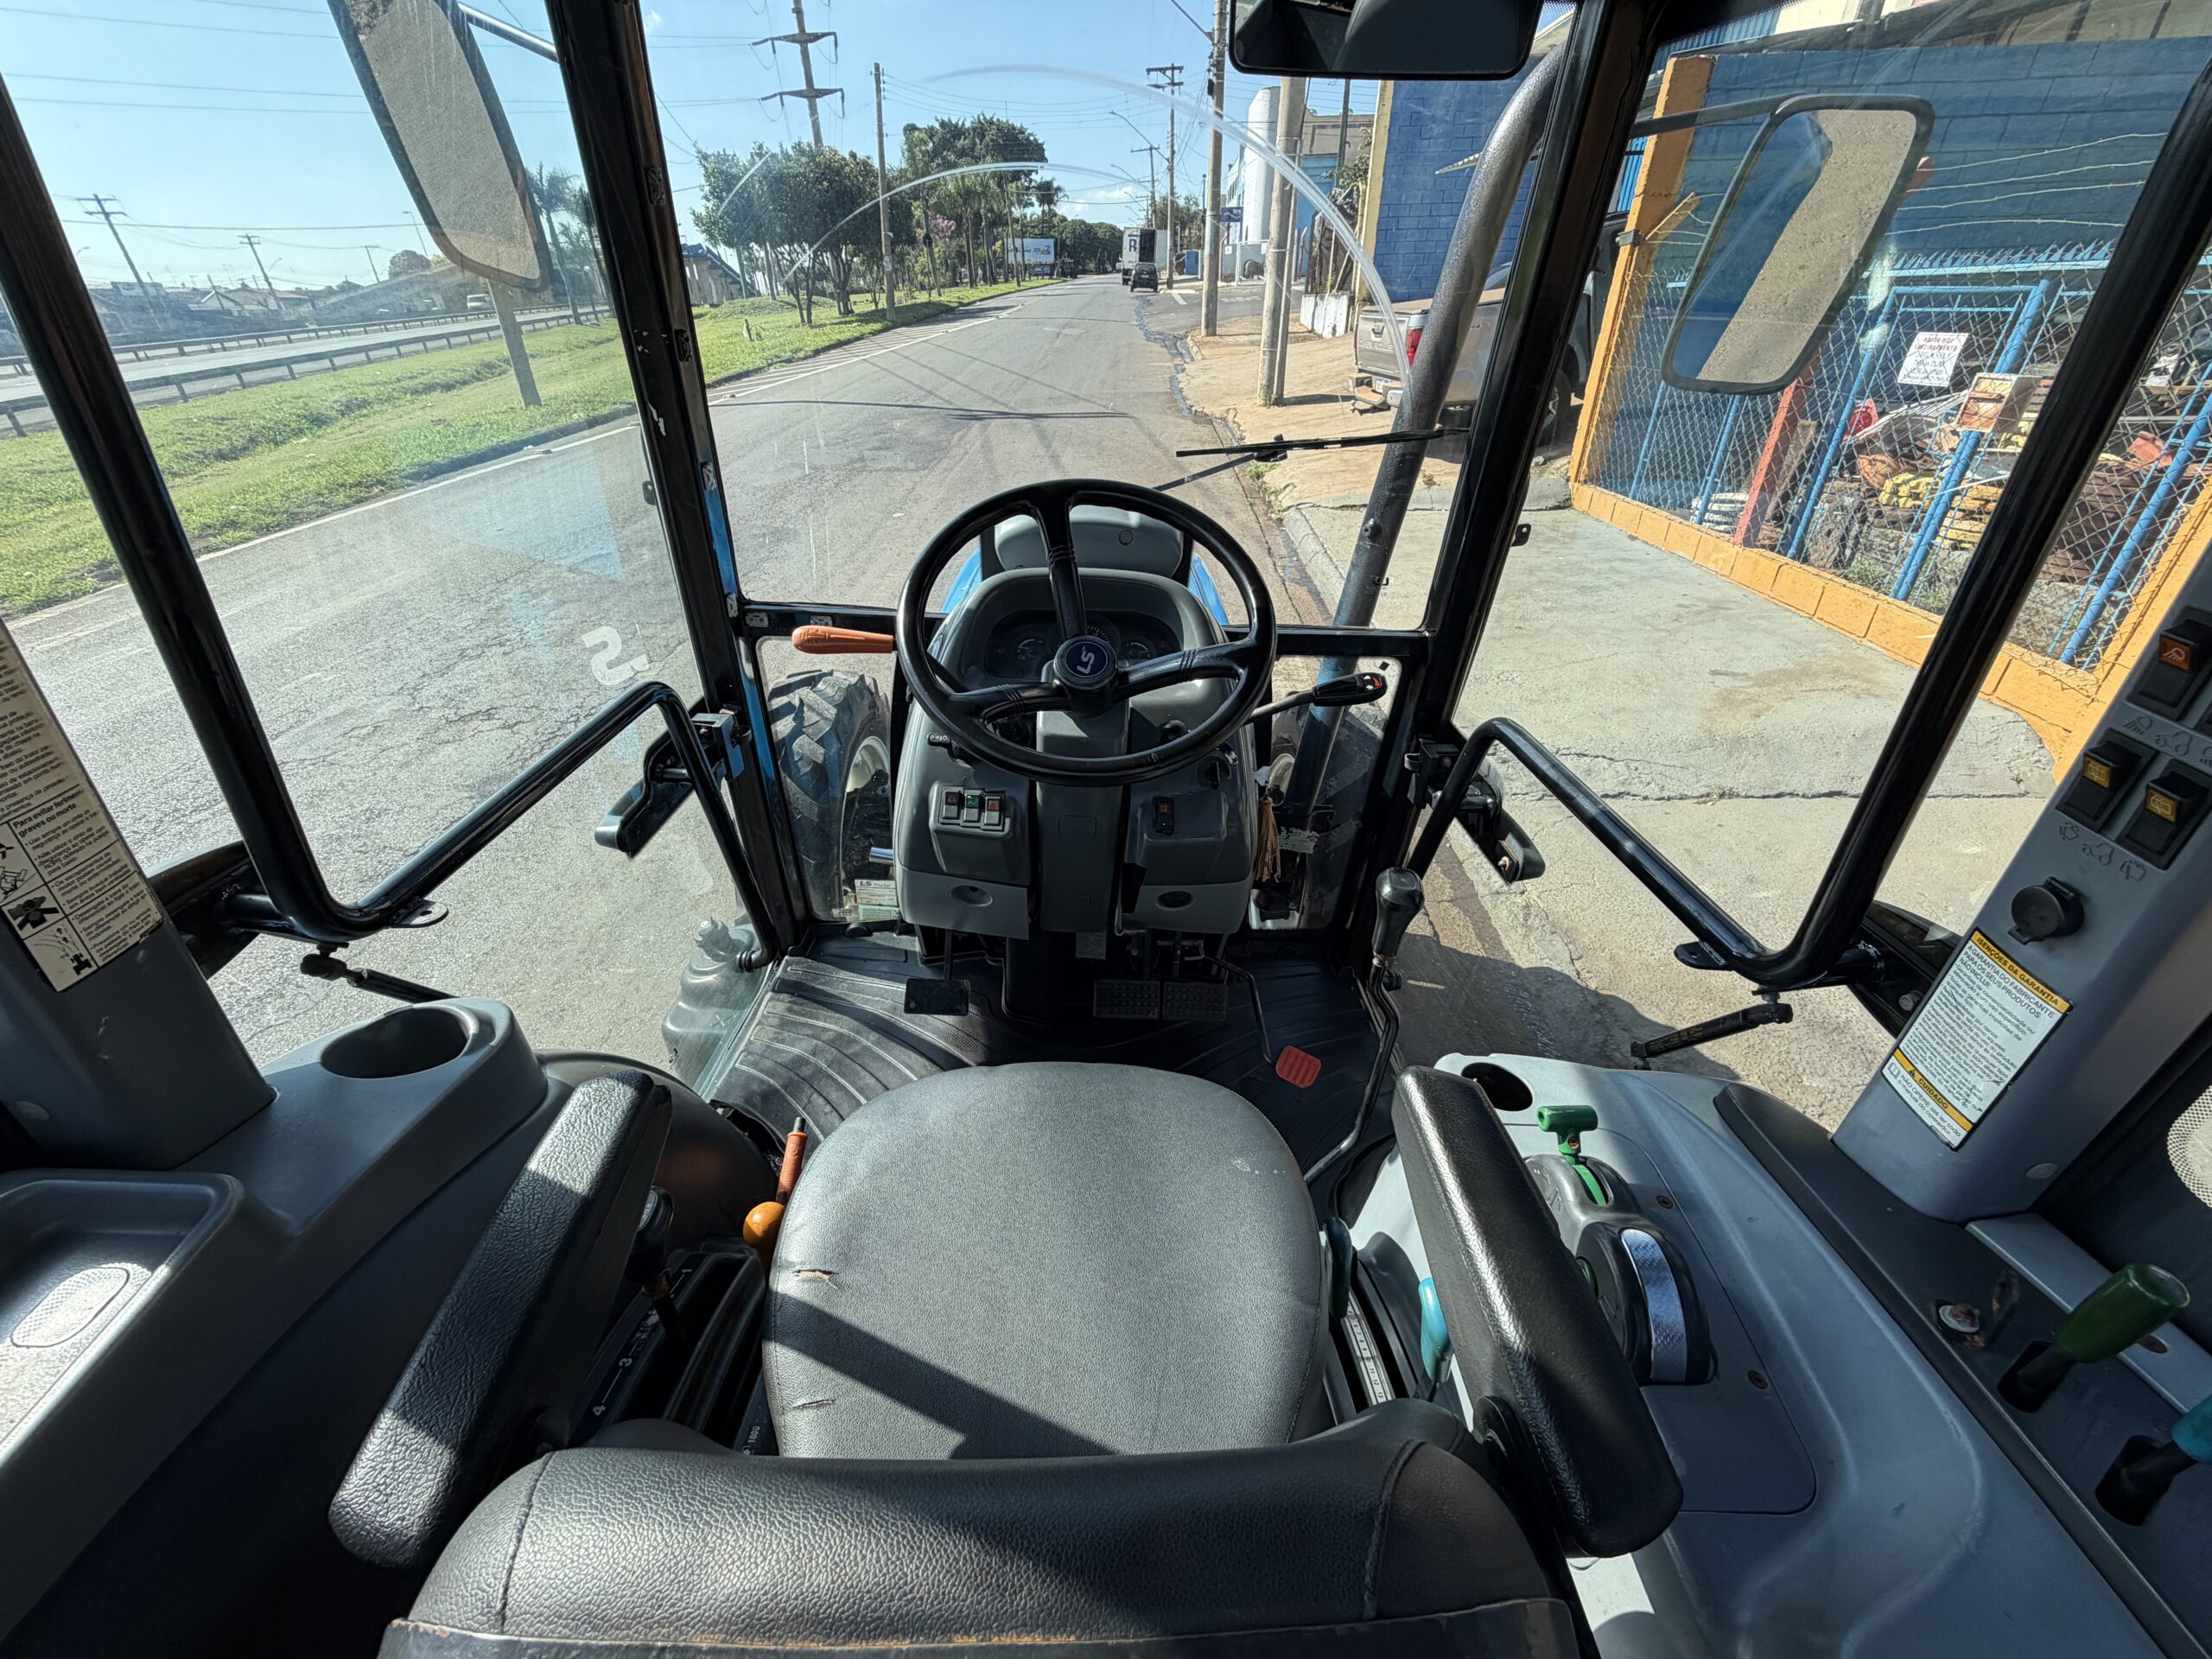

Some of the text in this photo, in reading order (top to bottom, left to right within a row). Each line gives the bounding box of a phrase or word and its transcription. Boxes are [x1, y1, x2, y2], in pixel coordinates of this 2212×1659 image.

[1076, 650, 1096, 674] LS
[12, 814, 33, 830] Para
[30, 803, 54, 820] evitar
[17, 817, 47, 839] graves
[44, 813, 56, 823] ou
[54, 801, 78, 817] morte
[1957, 956, 1993, 989] NÃO INCLUI:
[1961, 950, 2042, 1020] PARA OS SEUS PRODUTOS
[1969, 947, 2002, 976] GARANTIA
[1998, 972, 2011, 985] DO
[2008, 979, 2056, 1020] FABRICANTE
[1974, 936, 2060, 1007] ISENÇÕES DA GARANTIA
[1916, 1077, 1948, 1110] CUIDADO
[618, 1357, 633, 1368] 3
[592, 1404, 607, 1416] 4
